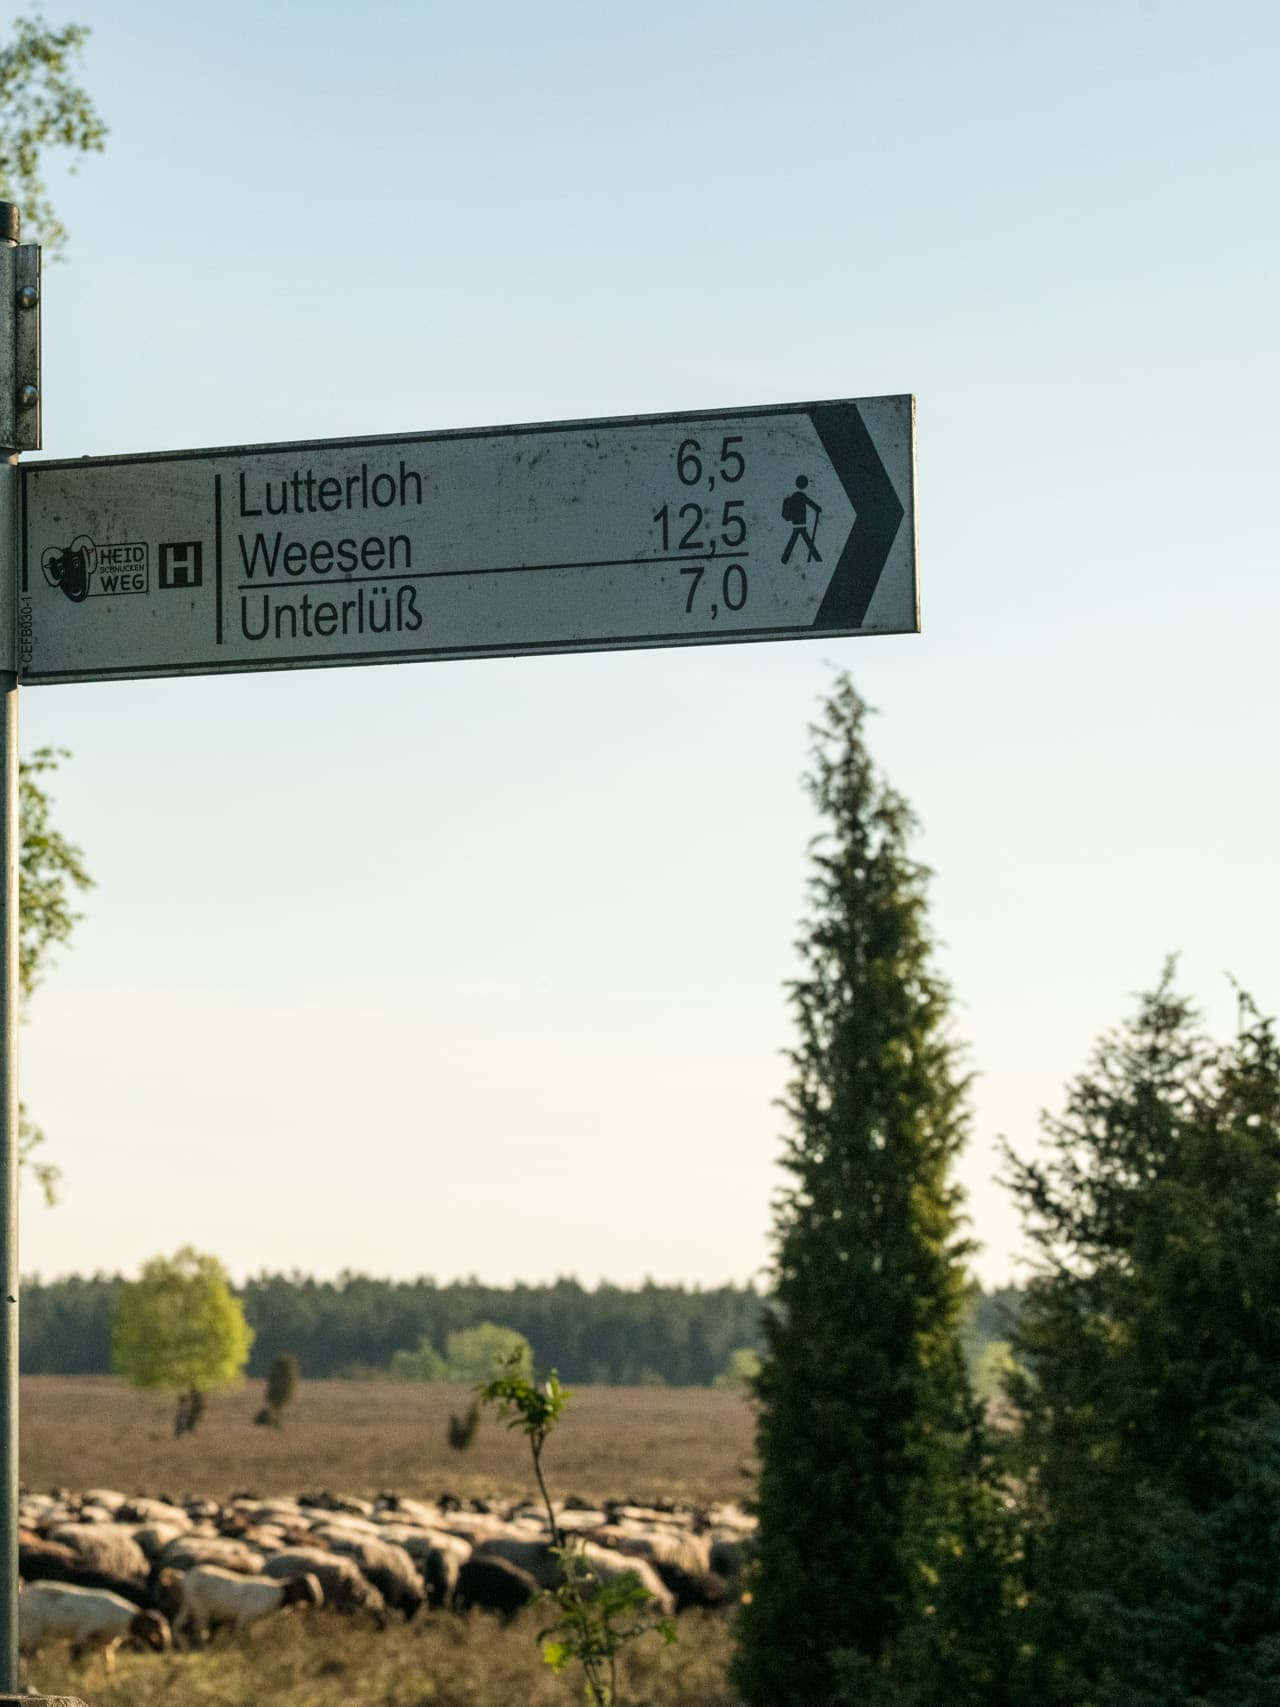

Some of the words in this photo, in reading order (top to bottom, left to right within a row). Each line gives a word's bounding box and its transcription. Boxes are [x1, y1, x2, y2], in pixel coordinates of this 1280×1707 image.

[238, 461, 423, 518] Lutterloh
[675, 435, 746, 492] 6,5
[100, 547, 145, 564] HEID
[238, 531, 412, 579] Weesen
[652, 499, 748, 556] 12,5
[99, 563, 145, 575] SCHNUCKEN
[100, 574, 145, 593] WEG
[165, 545, 195, 585] H
[240, 584, 424, 641] Unterlüß
[679, 563, 749, 620] 7,0
